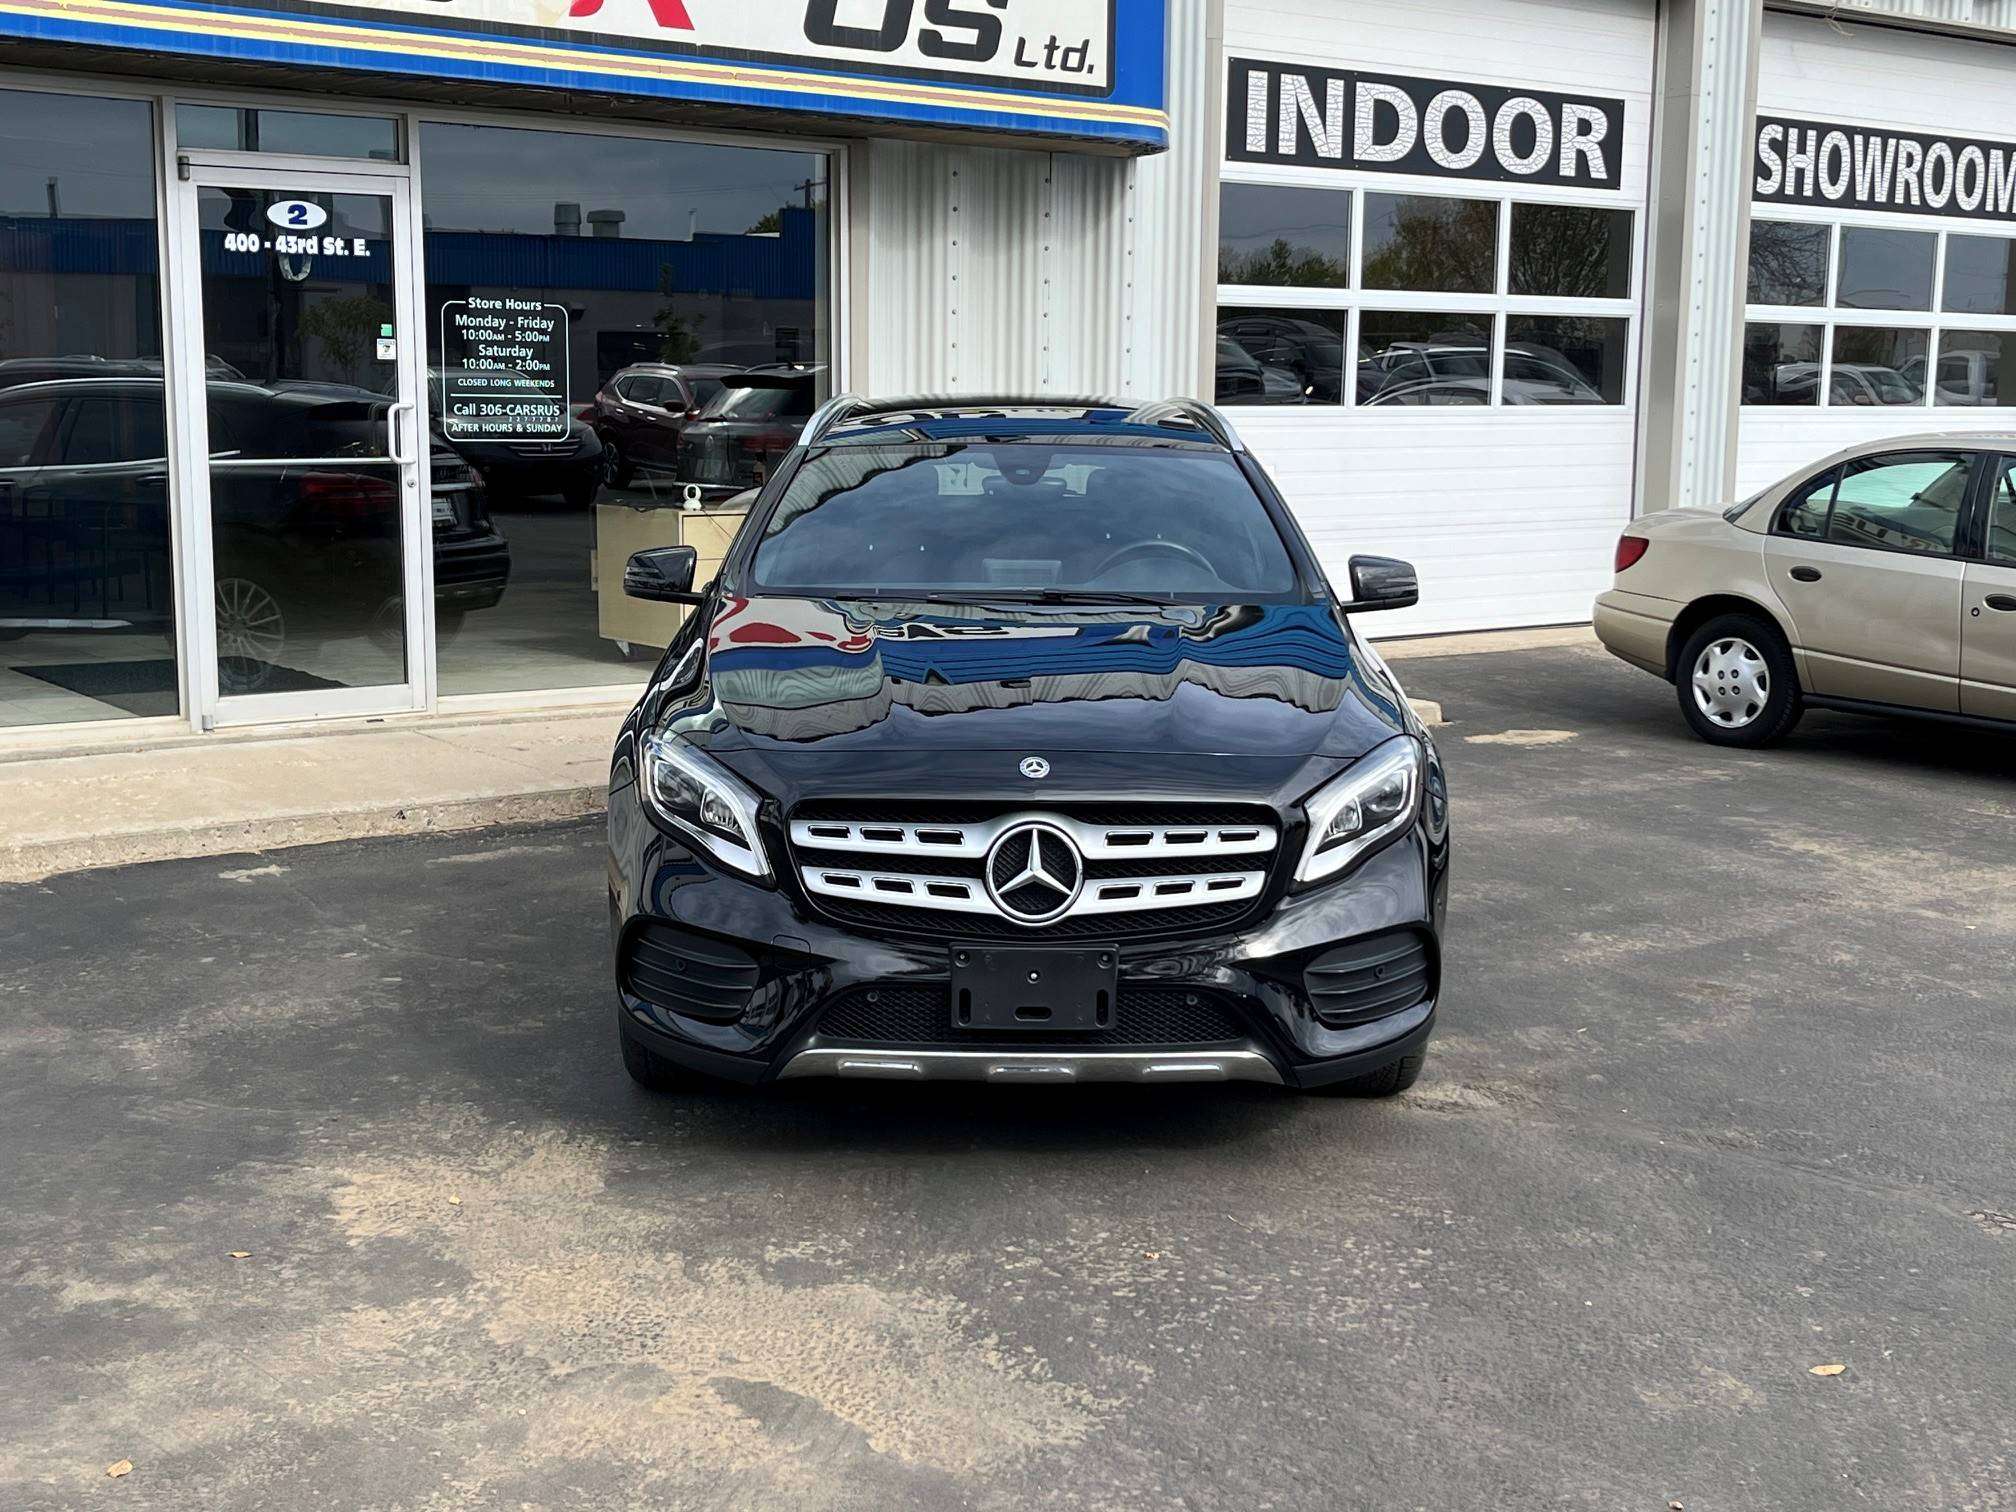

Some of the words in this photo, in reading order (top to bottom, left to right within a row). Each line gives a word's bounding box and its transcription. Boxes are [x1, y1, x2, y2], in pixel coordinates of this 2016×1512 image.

[1014, 35, 1094, 74] Ltd.
[1246, 69, 1609, 180] INDOOR
[1756, 124, 2016, 214] SHOWROOM
[287, 204, 308, 226] 2
[224, 233, 260, 253] 400
[275, 235, 319, 255] 43rd
[322, 236, 350, 256] St.
[353, 238, 371, 257] E.
[468, 297, 503, 310] Store
[505, 298, 542, 311] Hours
[455, 314, 507, 330] Monday
[517, 316, 555, 332] Friday
[461, 329, 505, 341] 10:00AM
[514, 330, 550, 342] 5:00PM
[478, 344, 534, 360] Saturday
[462, 358, 506, 370] 10:00AM
[515, 359, 551, 371] 2:00PM
[457, 378, 488, 387] CLOSED
[490, 378, 512, 387] LONG
[513, 379, 555, 388] WEEKENDS
[453, 403, 476, 416] Call
[479, 403, 560, 417] 306-CARSRUS
[451, 423, 480, 433] AFTER
[482, 423, 513, 433] HOURS
[516, 424, 523, 433] &
[526, 424, 563, 433] SUNDAY
